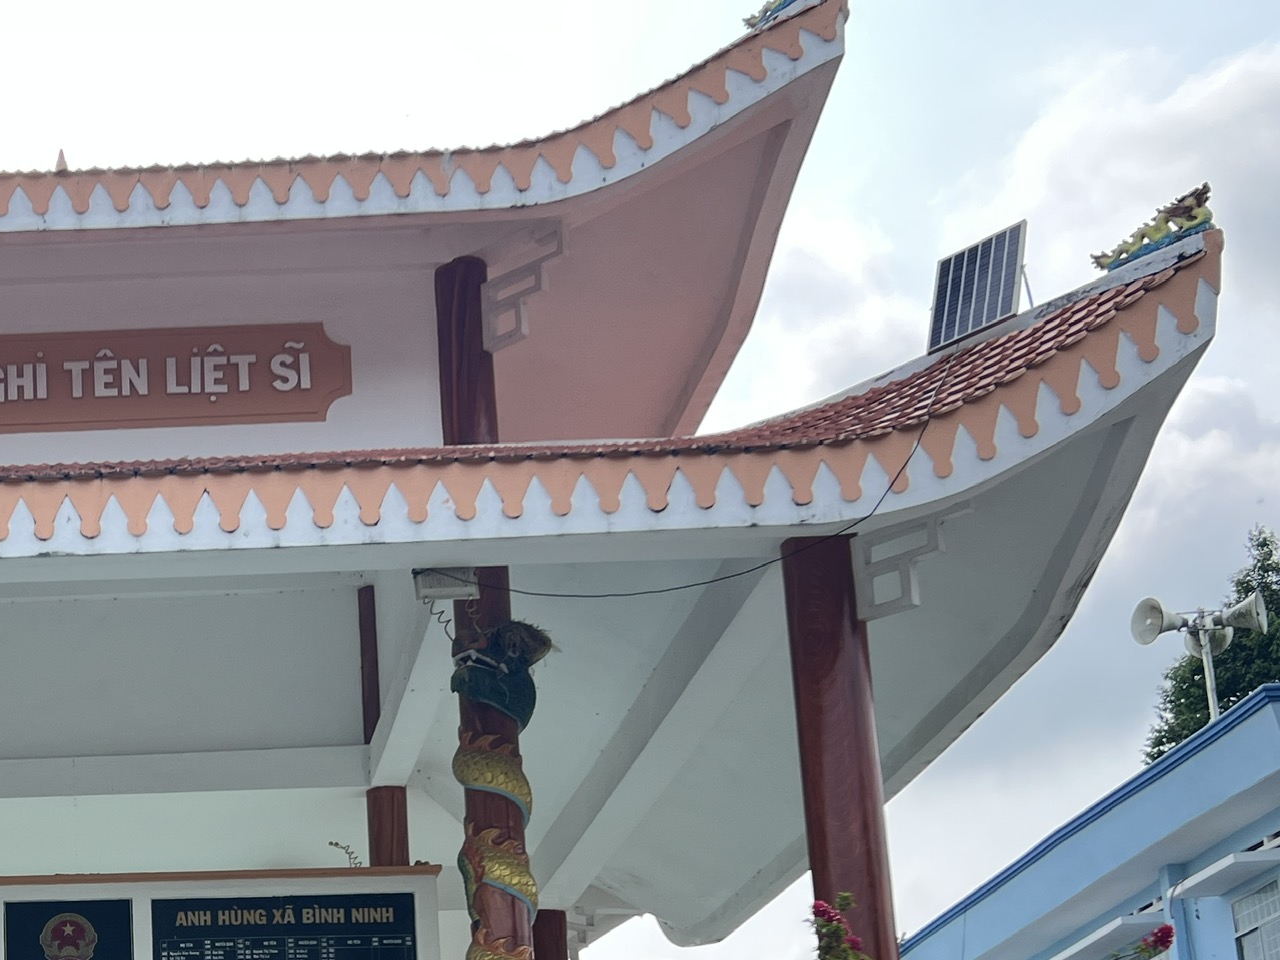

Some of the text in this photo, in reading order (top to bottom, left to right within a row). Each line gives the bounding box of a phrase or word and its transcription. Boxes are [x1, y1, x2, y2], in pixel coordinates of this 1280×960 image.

[64, 349, 149, 398] TÊN
[166, 344, 256, 402] LIỆT
[271, 341, 311, 391] SĨ
[176, 905, 394, 927] ANH HÙNG XÃ BÌNH NINH
